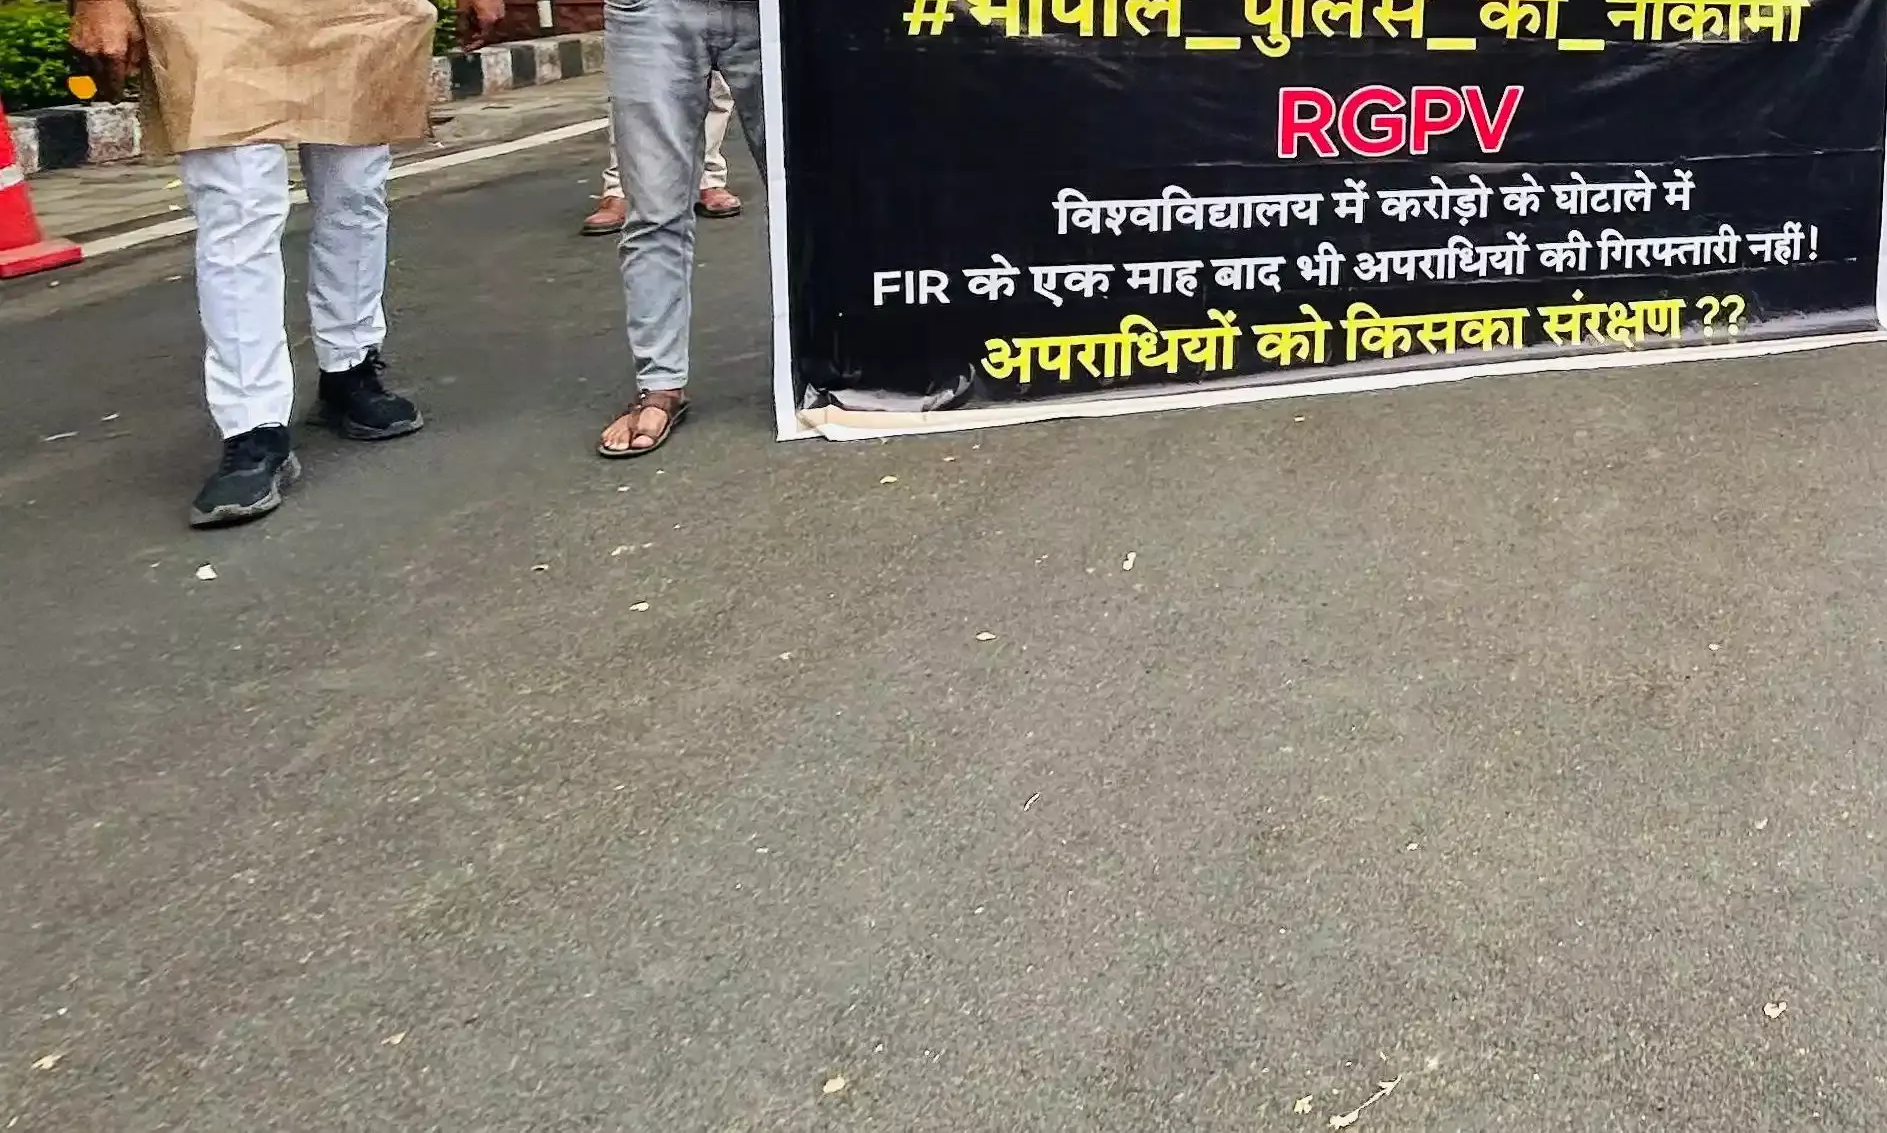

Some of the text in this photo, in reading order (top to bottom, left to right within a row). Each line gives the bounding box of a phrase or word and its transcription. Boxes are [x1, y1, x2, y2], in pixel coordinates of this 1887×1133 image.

[1278, 86, 1524, 159] RGPV
[1052, 169, 1695, 236] विश्वविद्यालय में करोड़ो के घोटाले में
[873, 269, 951, 306] FIR
[962, 253, 1020, 302] के
[1028, 263, 1115, 308] एक
[1123, 260, 1203, 297] माह
[1209, 256, 1286, 293] बाद
[1296, 242, 1345, 286] भी
[1353, 231, 1529, 283] अपराधियों
[1536, 230, 1592, 274] की
[1596, 224, 1740, 270] गिरफ्तारी
[981, 288, 1746, 384] अपराधियों को किसका संरक्षण ??
